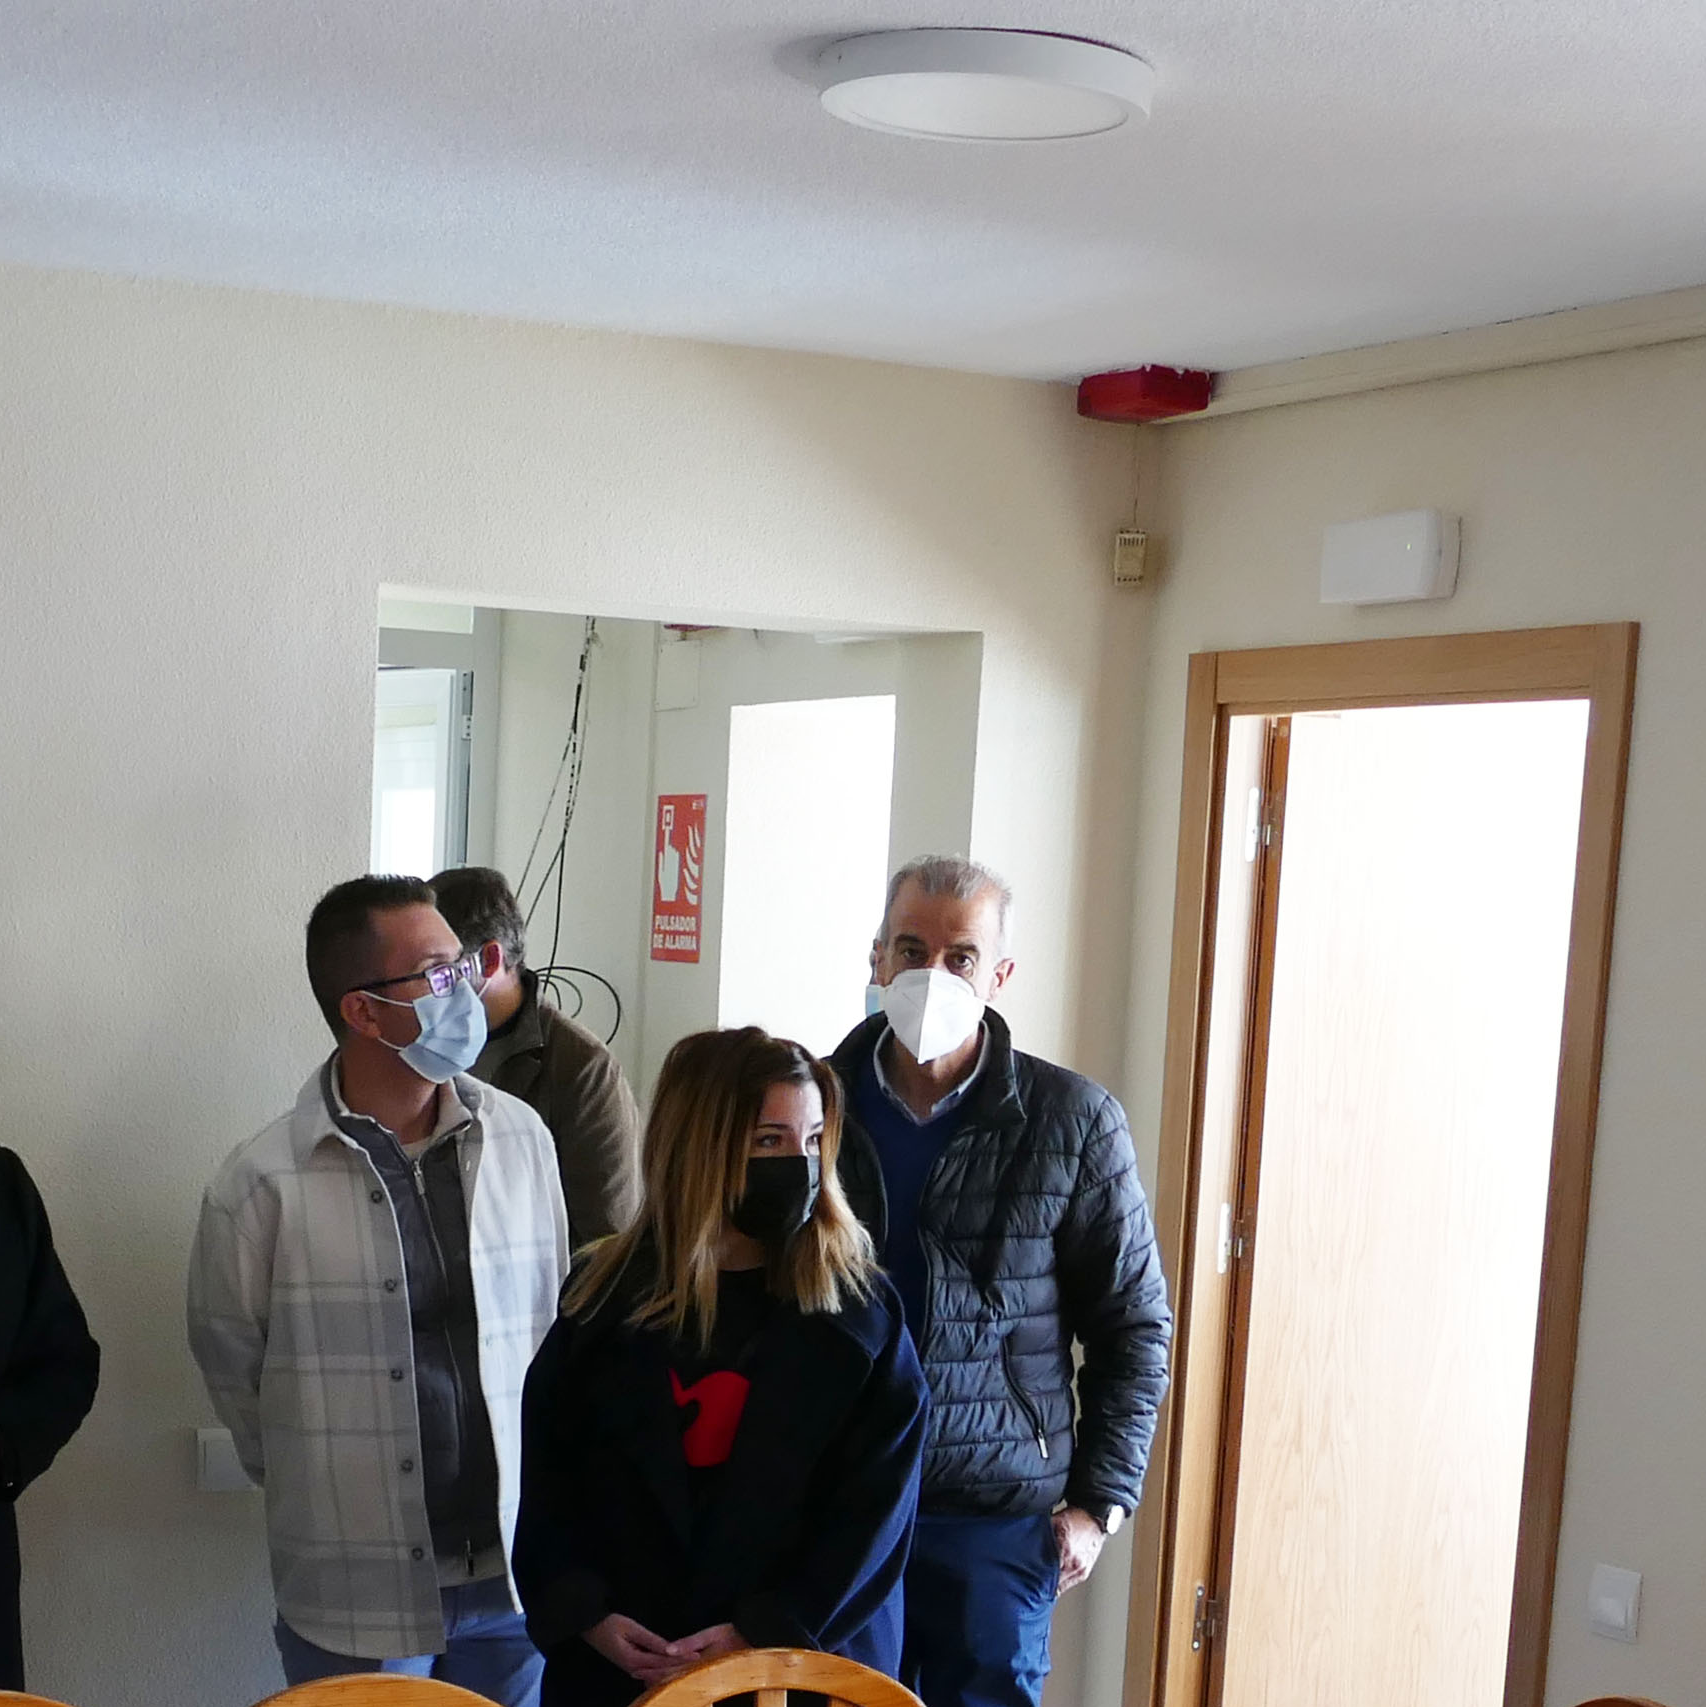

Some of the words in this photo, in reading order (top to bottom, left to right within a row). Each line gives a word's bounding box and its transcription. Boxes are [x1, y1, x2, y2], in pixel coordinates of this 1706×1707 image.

[655, 914, 696, 931] PULSADOR
[653, 934, 664, 948] DE
[664, 934, 697, 950] ALARMA
